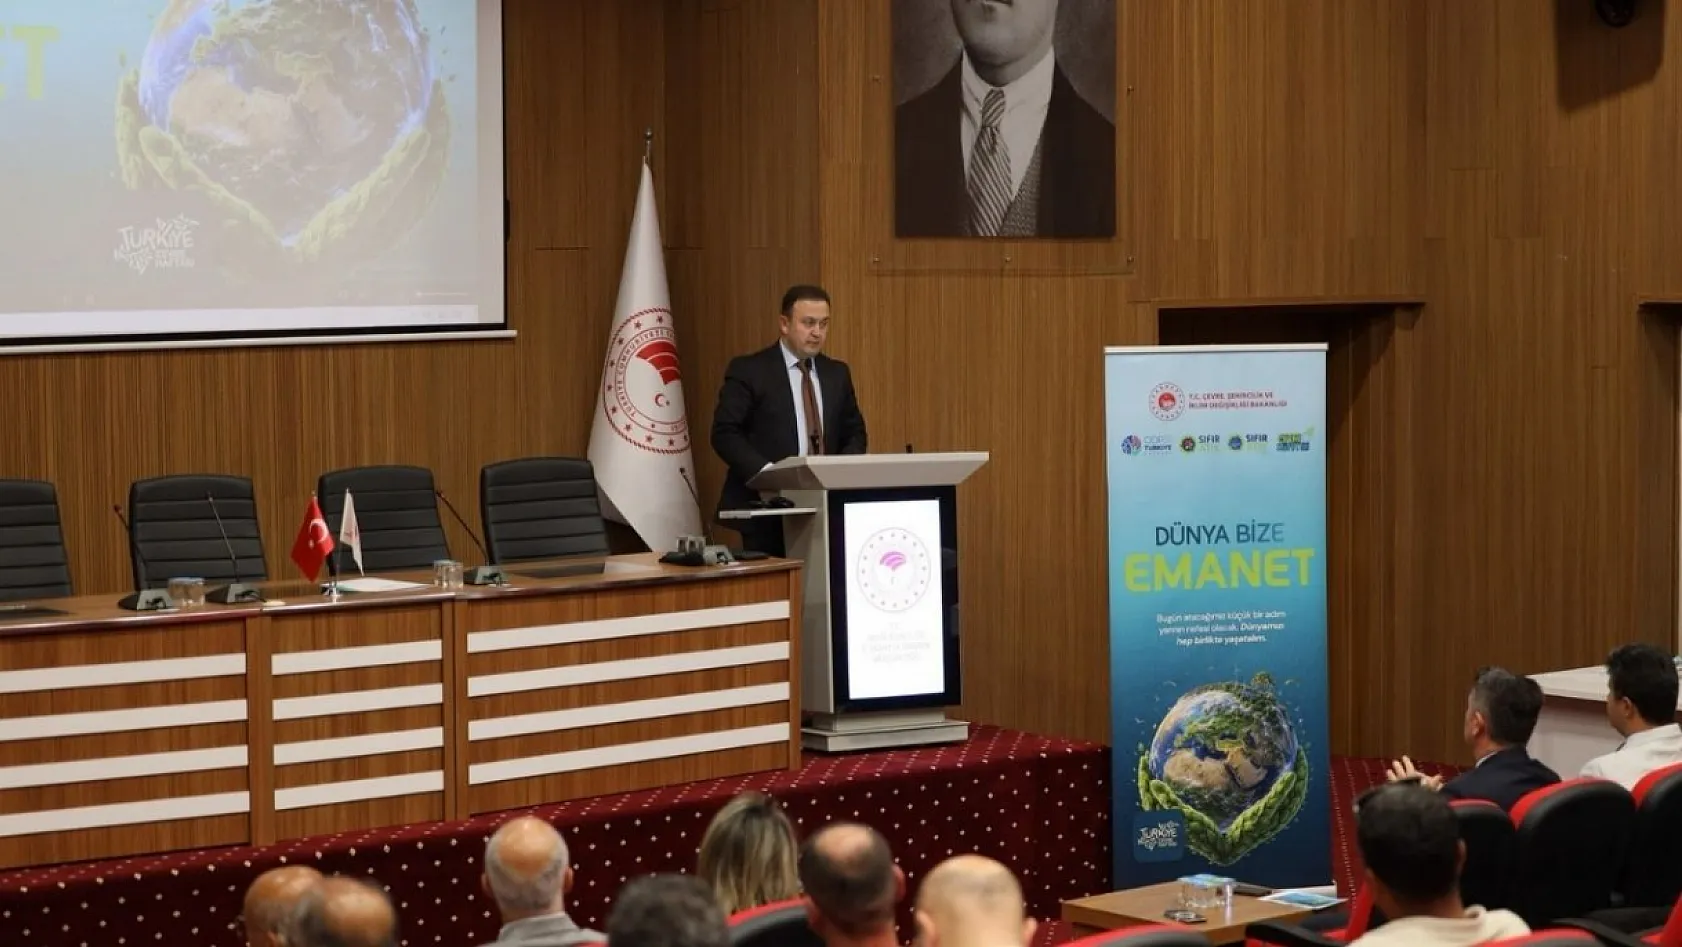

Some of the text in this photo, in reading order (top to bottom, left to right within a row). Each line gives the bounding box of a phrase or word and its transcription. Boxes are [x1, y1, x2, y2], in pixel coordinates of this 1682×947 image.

[0, 25, 60, 100] T
[1155, 518, 1285, 546] DÜNYA BİZE
[1124, 548, 1315, 592] EMANET
[1157, 613, 1183, 624] Bugün
[1227, 609, 1251, 622] küçük
[1252, 609, 1263, 619] bir
[1264, 609, 1286, 618] adım
[1177, 636, 1192, 647] hep
[1193, 635, 1223, 644] birlikte
